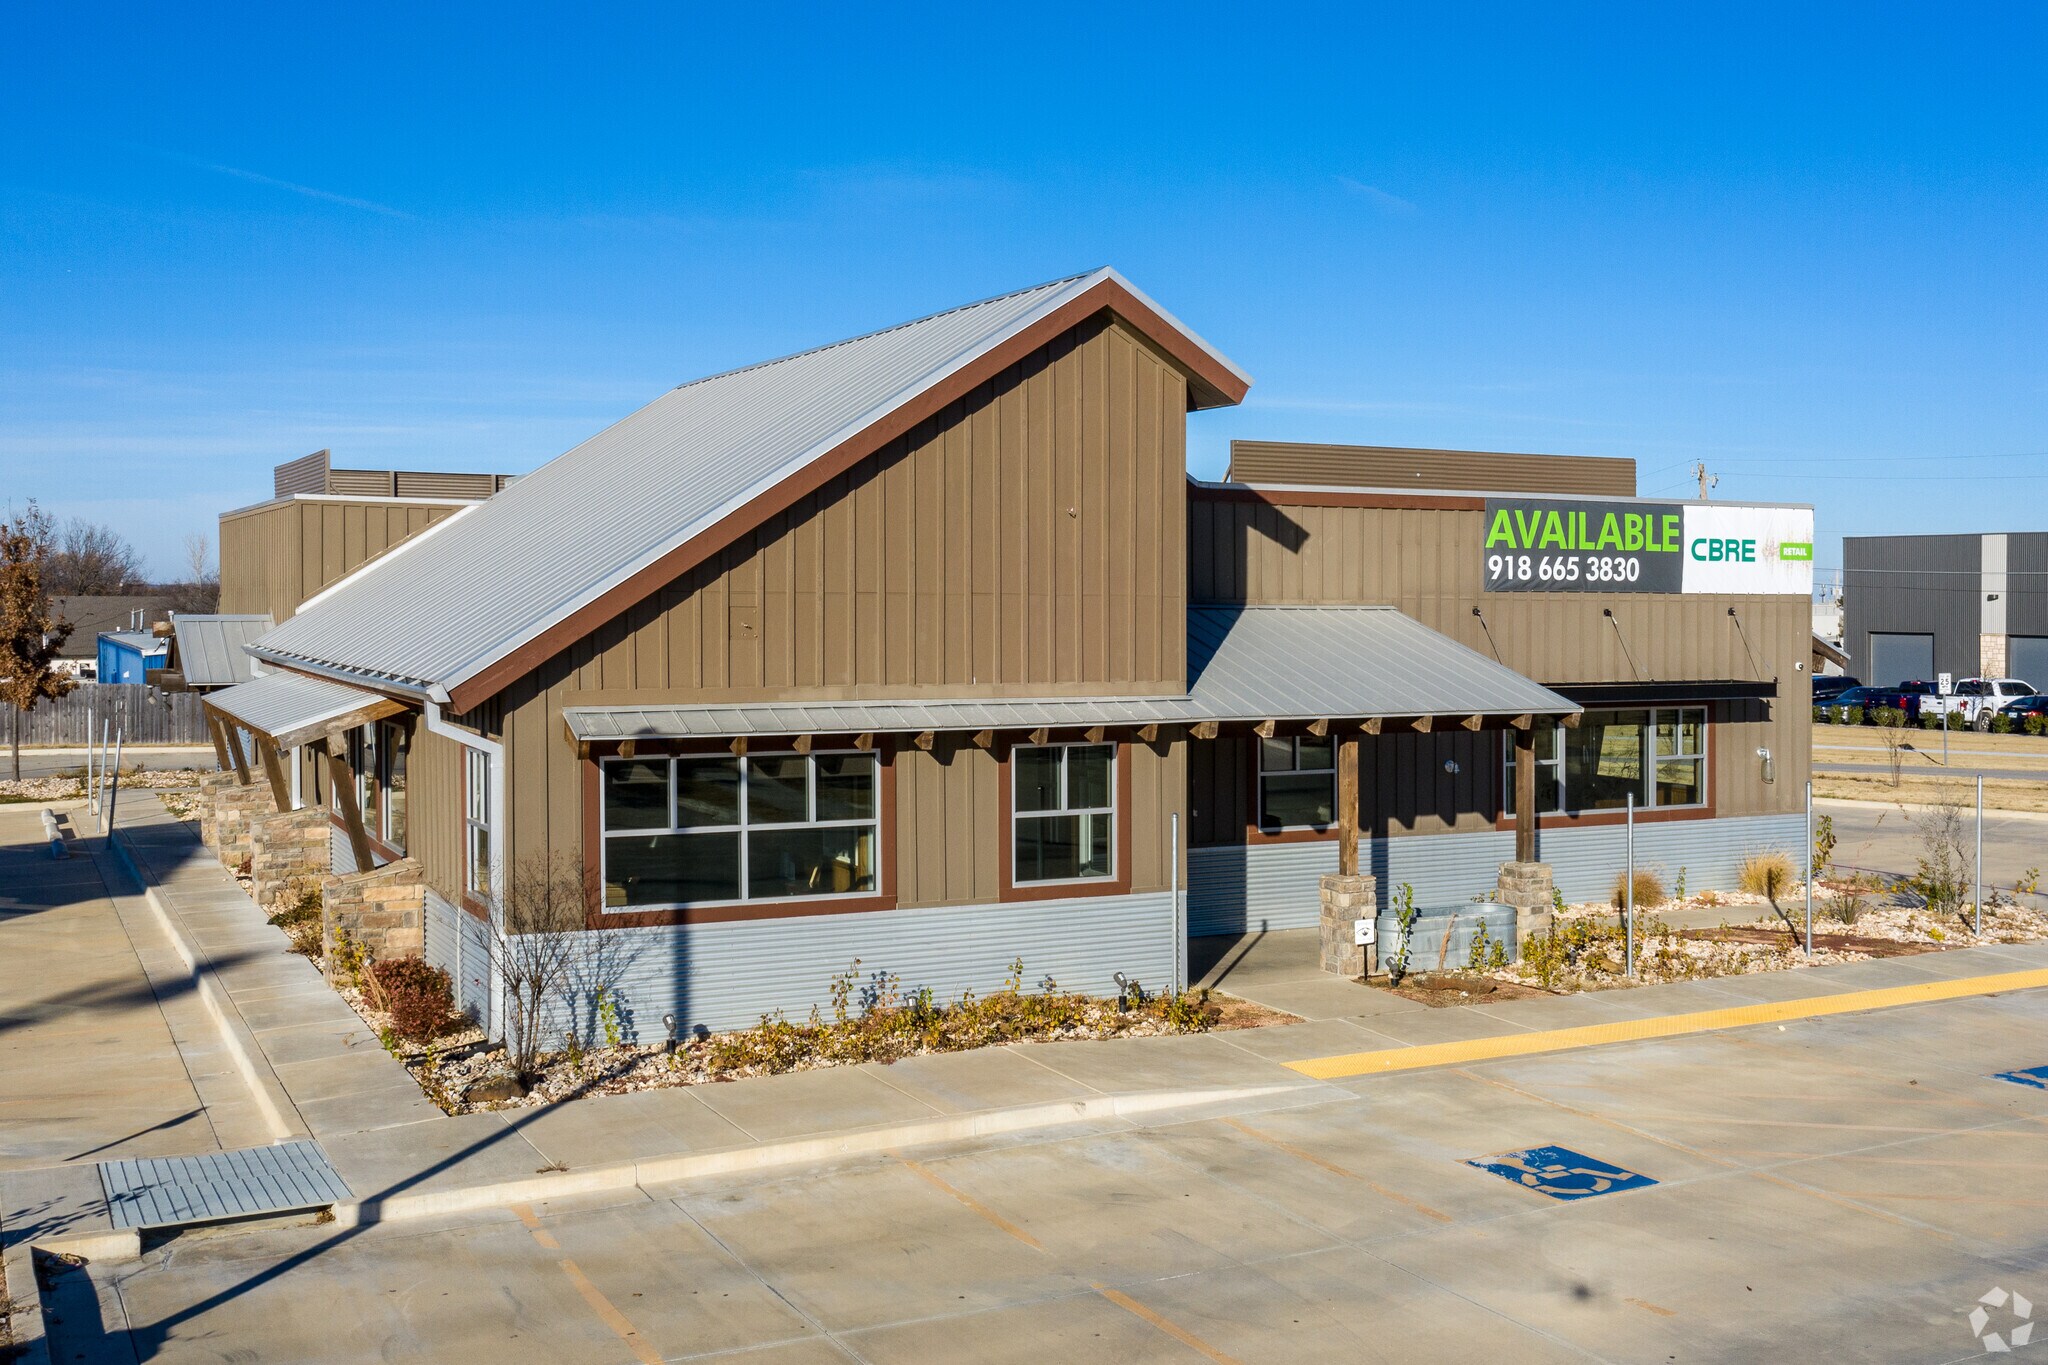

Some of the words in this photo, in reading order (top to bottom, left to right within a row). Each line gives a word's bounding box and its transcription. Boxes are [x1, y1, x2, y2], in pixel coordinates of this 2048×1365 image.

[1485, 509, 1680, 552] AVAILABLE
[1691, 538, 1757, 562] CBRE
[1783, 547, 1808, 556] RETAIL
[1488, 555, 1532, 581] 918
[1538, 556, 1580, 581] 665
[1585, 557, 1640, 582] 3830
